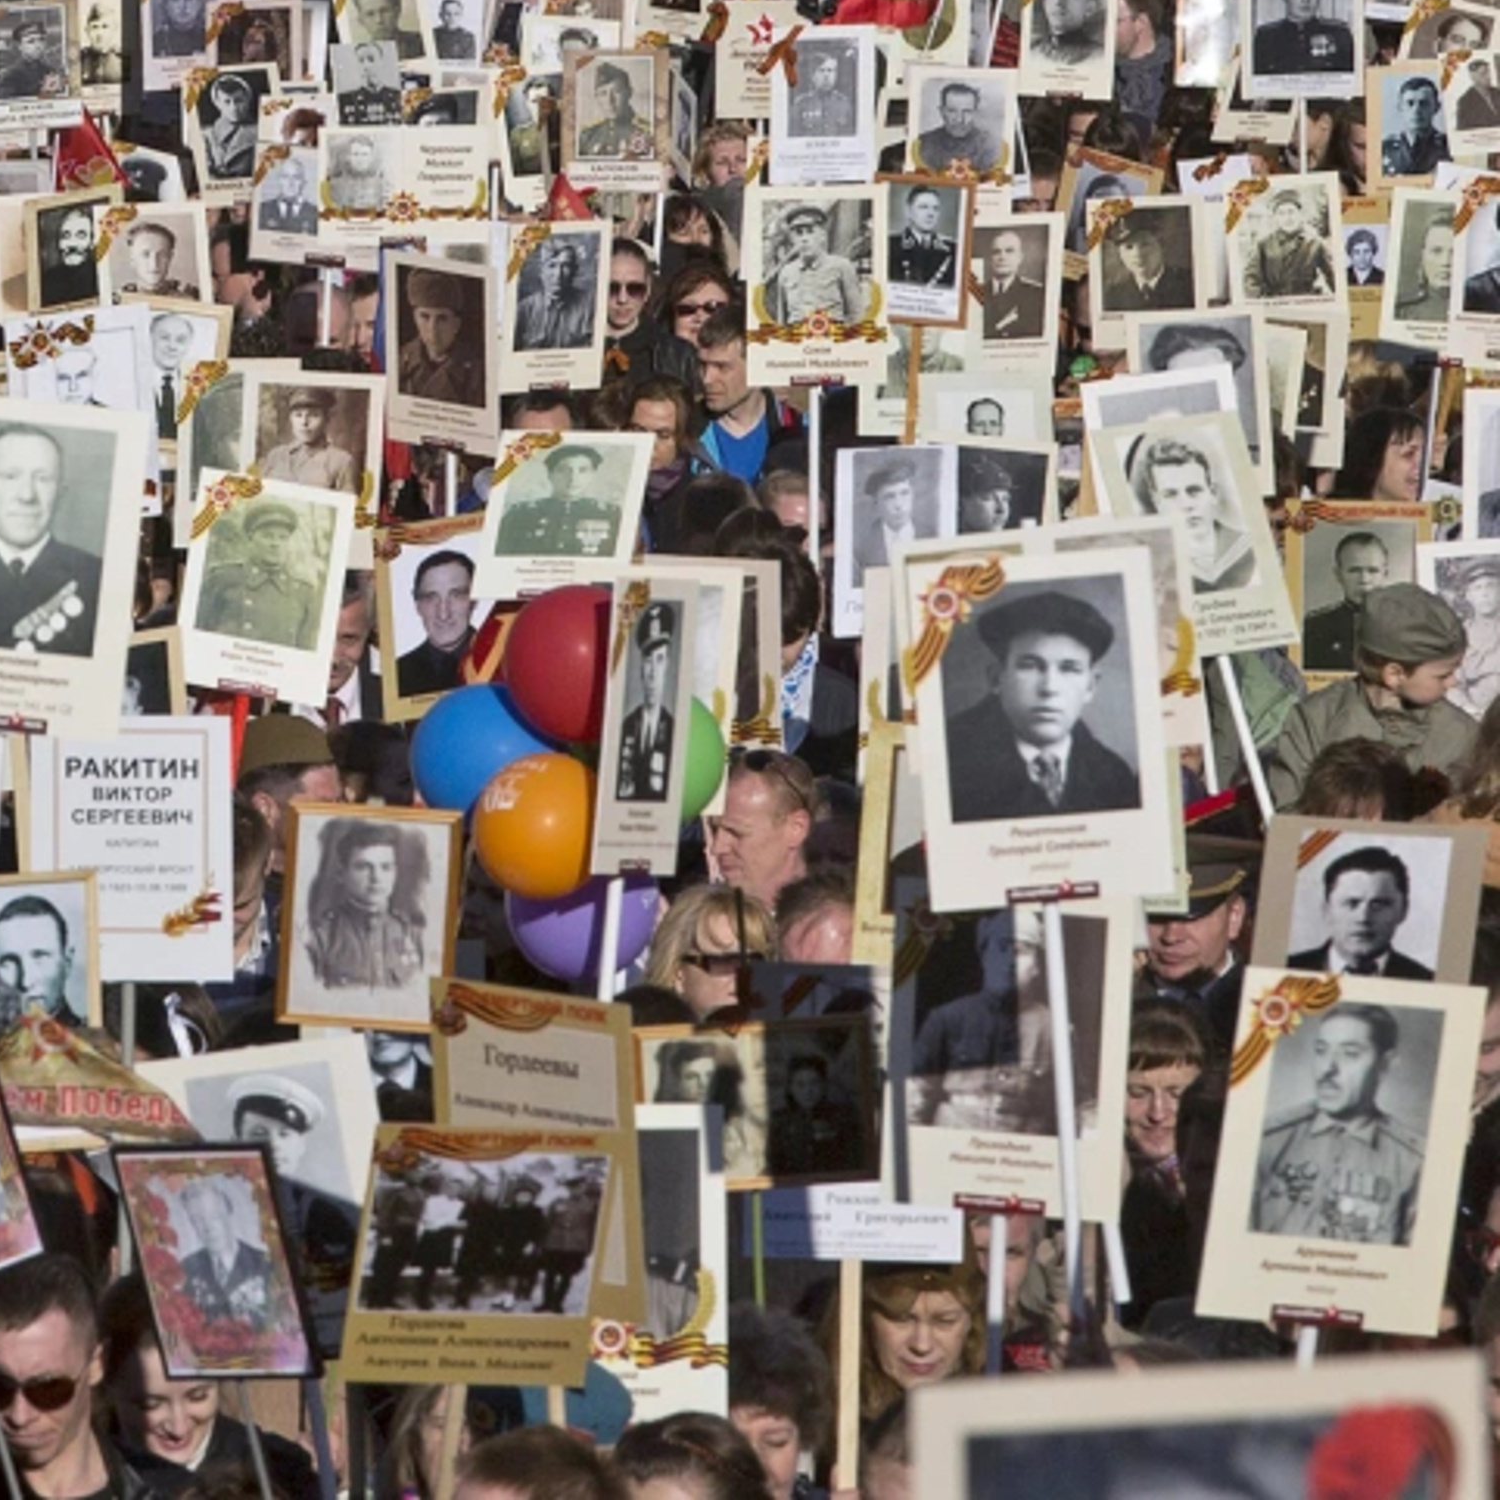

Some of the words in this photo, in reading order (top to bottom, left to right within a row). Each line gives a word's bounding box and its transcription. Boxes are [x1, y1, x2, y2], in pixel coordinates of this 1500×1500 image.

[64, 757, 199, 780] РАКИТИН
[92, 786, 172, 802] ВИКТОР
[71, 808, 194, 825] СЕРГЕЕВИЧ
[483, 1042, 580, 1080] Гордеевы
